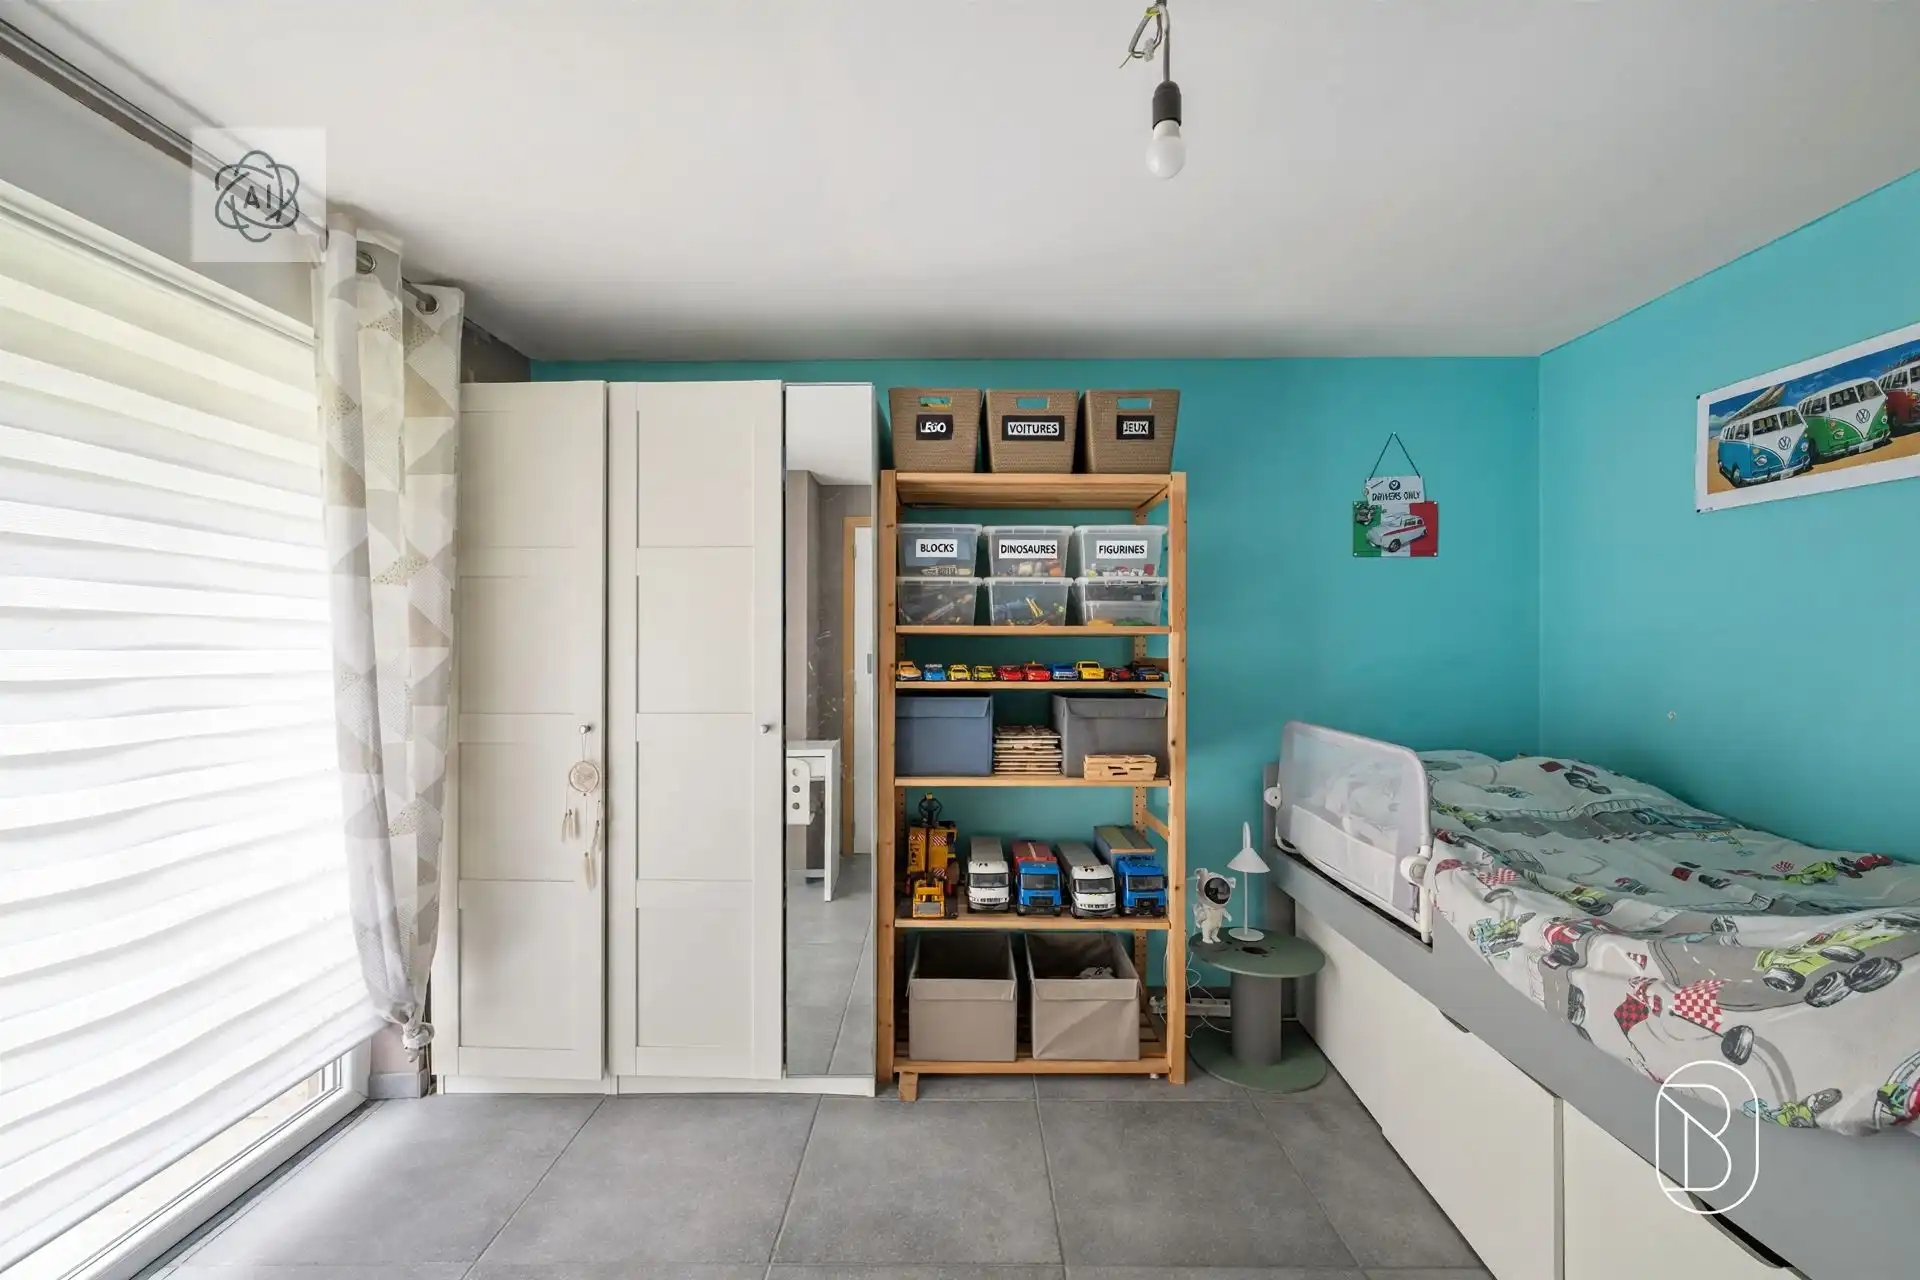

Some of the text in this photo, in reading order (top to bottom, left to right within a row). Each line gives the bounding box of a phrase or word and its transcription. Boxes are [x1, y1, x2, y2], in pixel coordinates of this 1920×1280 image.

[1009, 423, 1058, 434] VOITURES
[1123, 422, 1147, 433] JEUX
[1403, 490, 1421, 500] ONLY
[920, 543, 954, 553] BLOCKS
[1001, 544, 1056, 554] DINOSAURES
[1099, 544, 1145, 555] FIGURINES
